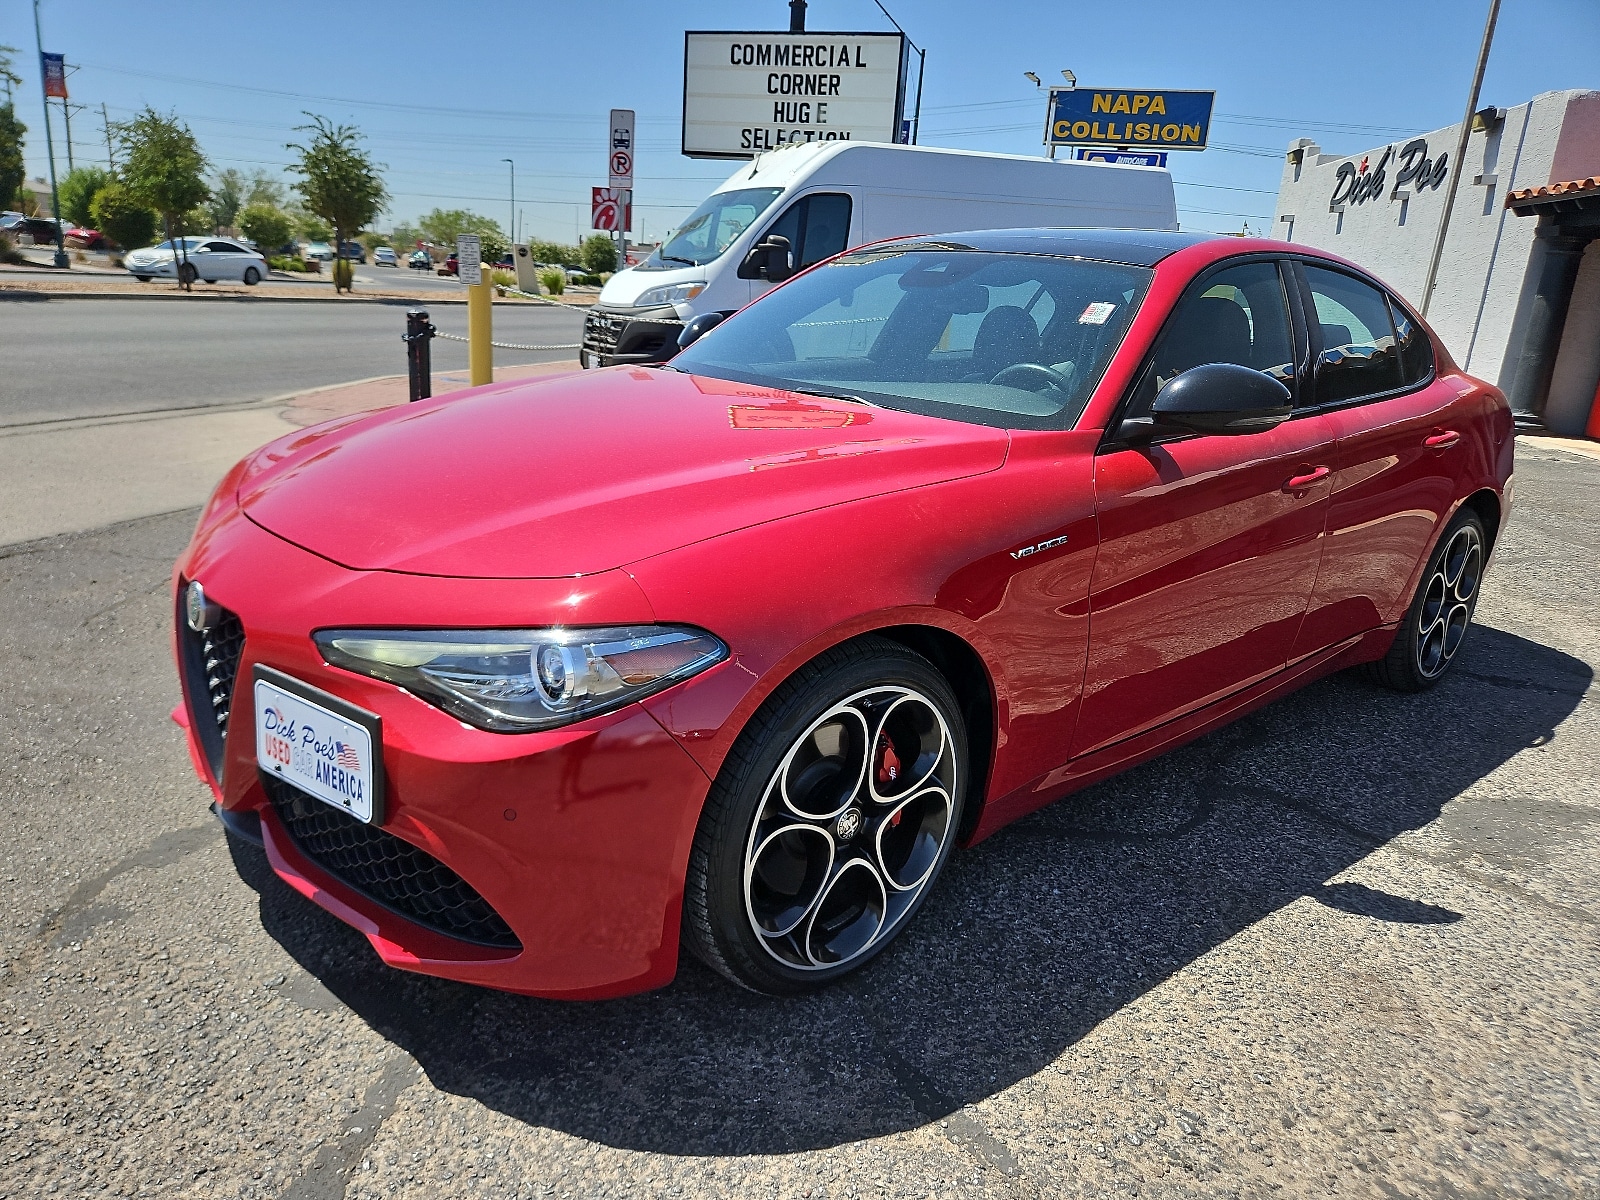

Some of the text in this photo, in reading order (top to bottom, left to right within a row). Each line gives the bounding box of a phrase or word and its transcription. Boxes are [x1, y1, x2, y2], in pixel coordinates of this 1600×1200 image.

[730, 44, 867, 68] COMMERCIAL
[767, 73, 841, 96] CORNER
[1092, 93, 1166, 115] NAPA
[1054, 120, 1201, 142] COLLISION
[1330, 138, 1448, 206] Dick Poe
[1010, 535, 1068, 560] VELOCE
[264, 705, 336, 761] Dick Poe's
[265, 733, 364, 803] USED CAR AMERICA
